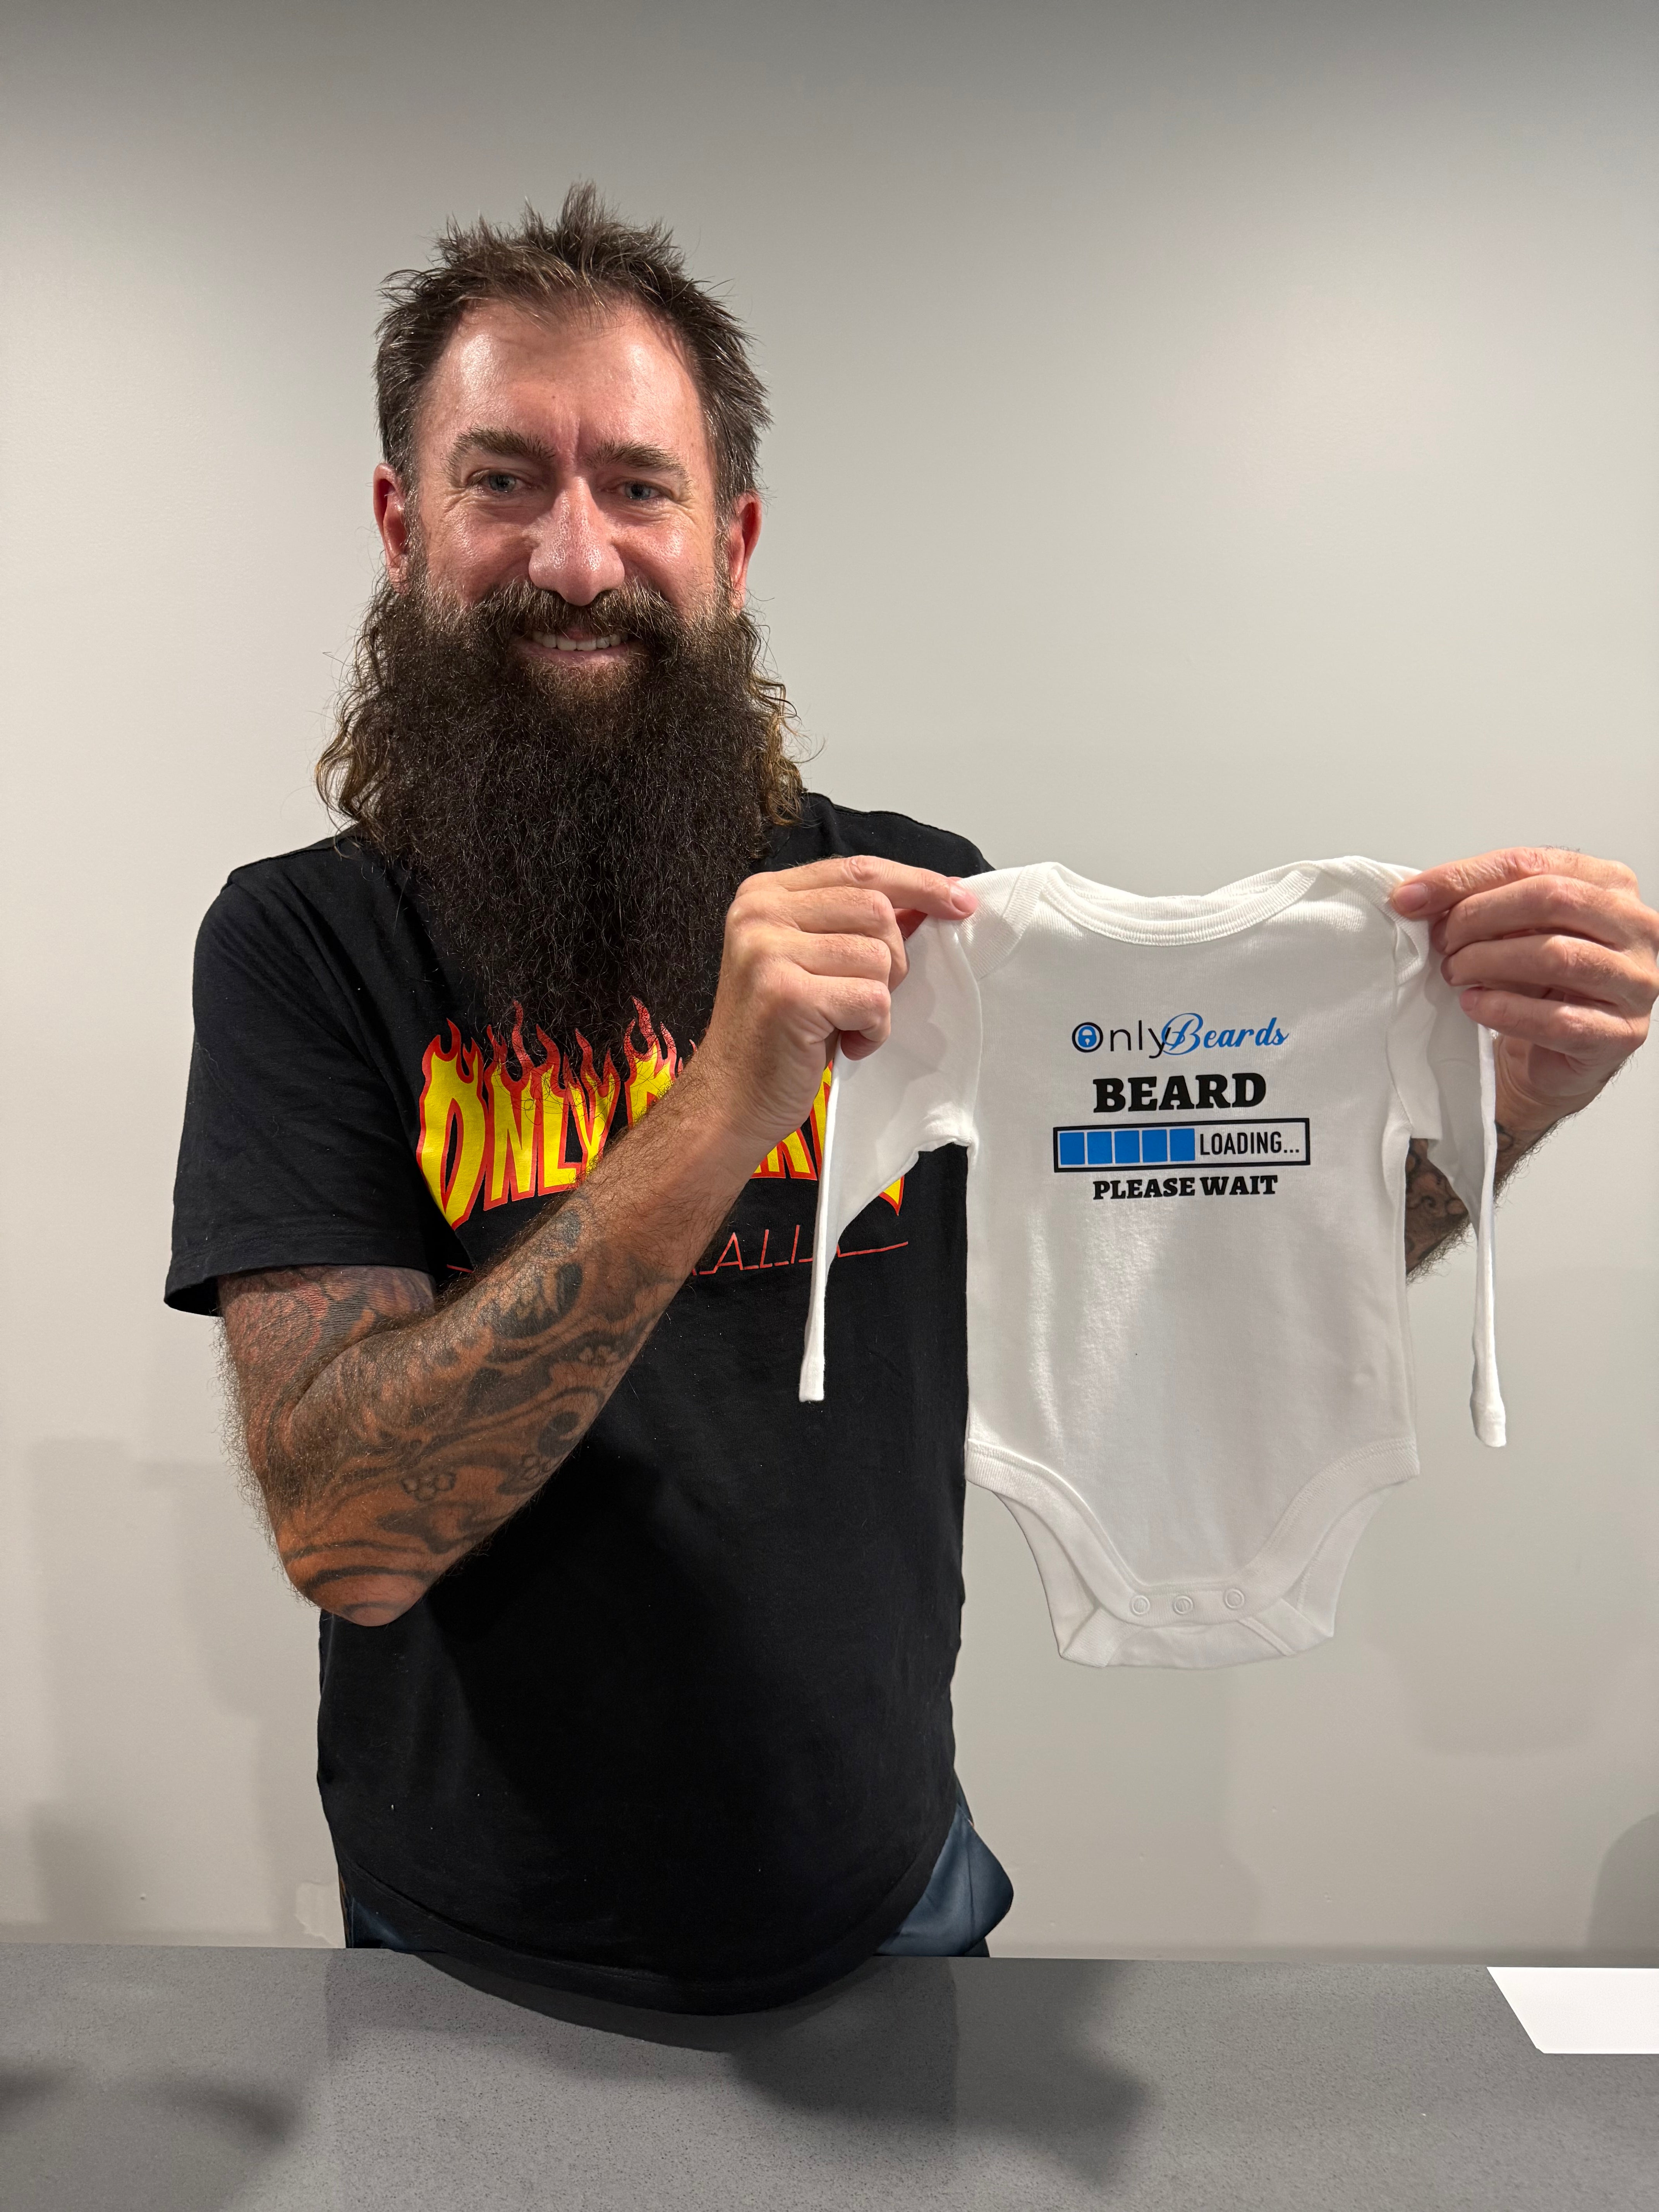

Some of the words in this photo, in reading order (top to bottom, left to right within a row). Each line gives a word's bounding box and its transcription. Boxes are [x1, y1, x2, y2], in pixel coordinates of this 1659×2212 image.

[1092, 1072, 1266, 1113] BEARD
[416, 1000, 620, 1230] ONLY
[1200, 1132, 1299, 1155] LOADING...
[1093, 1177, 1195, 1200] PLEASE
[1200, 1175, 1278, 1195] WAIT
